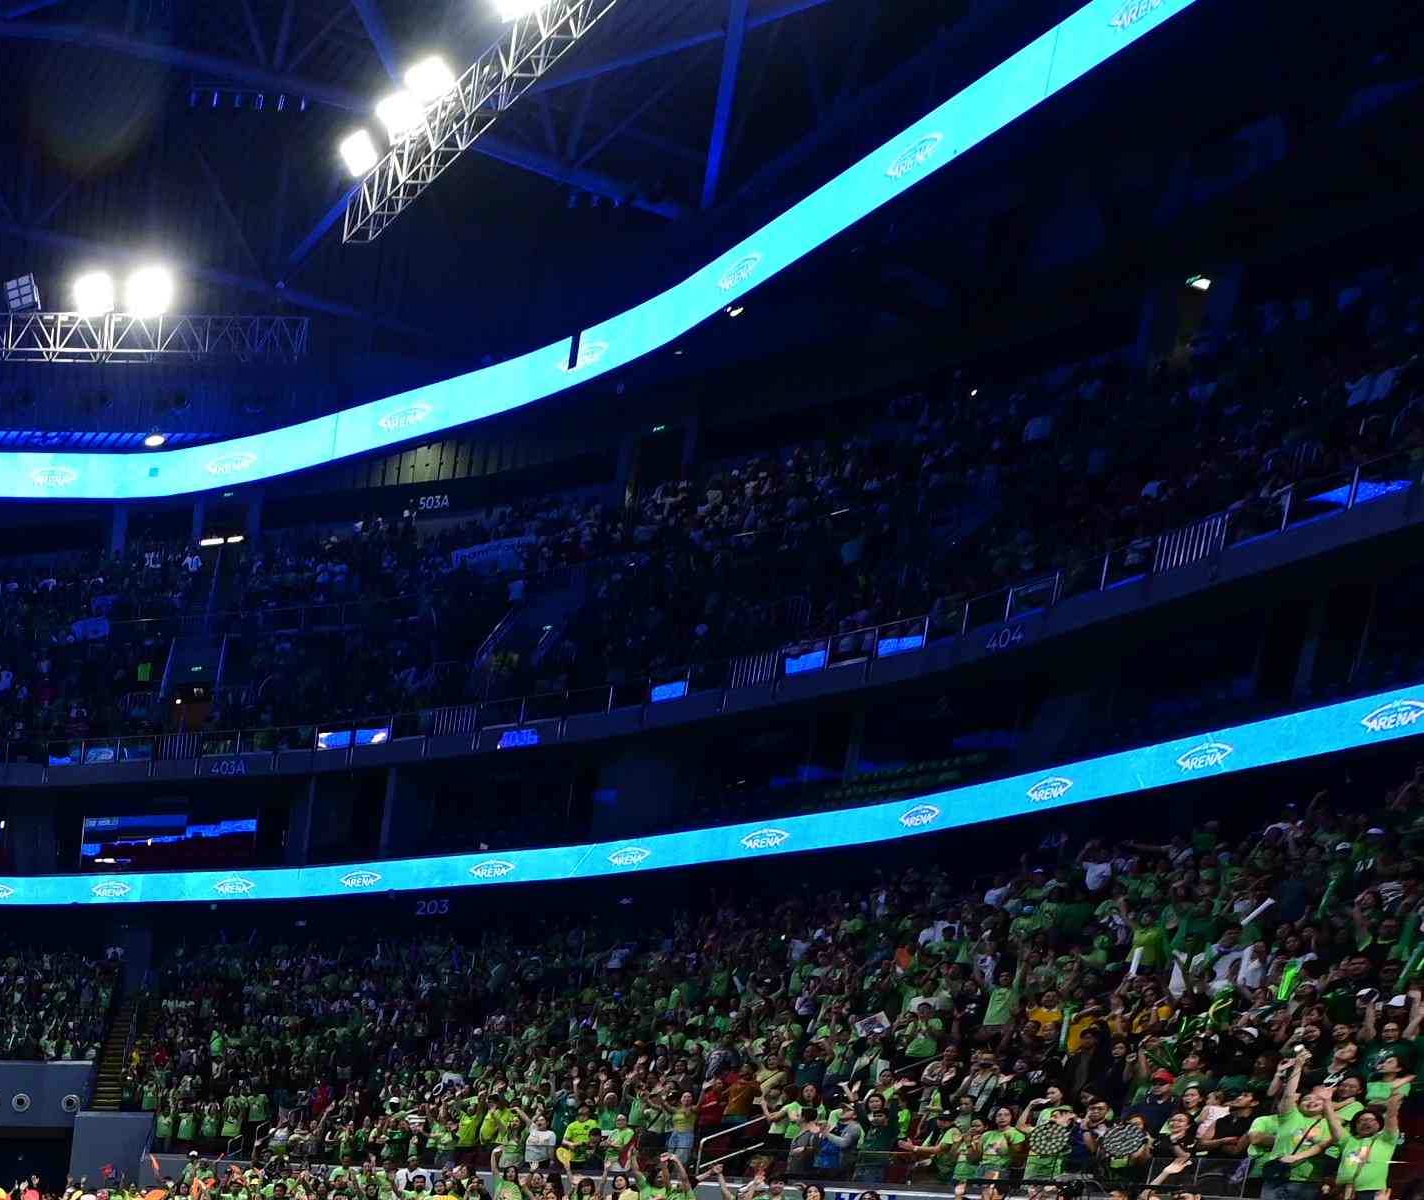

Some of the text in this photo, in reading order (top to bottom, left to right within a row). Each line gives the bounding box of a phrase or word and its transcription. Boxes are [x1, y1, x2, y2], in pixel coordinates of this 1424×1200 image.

[419, 494, 450, 510] 503A
[986, 628, 1025, 649] 404
[1369, 707, 1419, 733] ARENA
[1184, 752, 1225, 771] ARENA
[1032, 784, 1065, 802] ARENA
[747, 836, 782, 849] ARENA
[476, 866, 510, 878] ARENA
[344, 876, 374, 888] ARENA
[417, 899, 450, 915] 203
